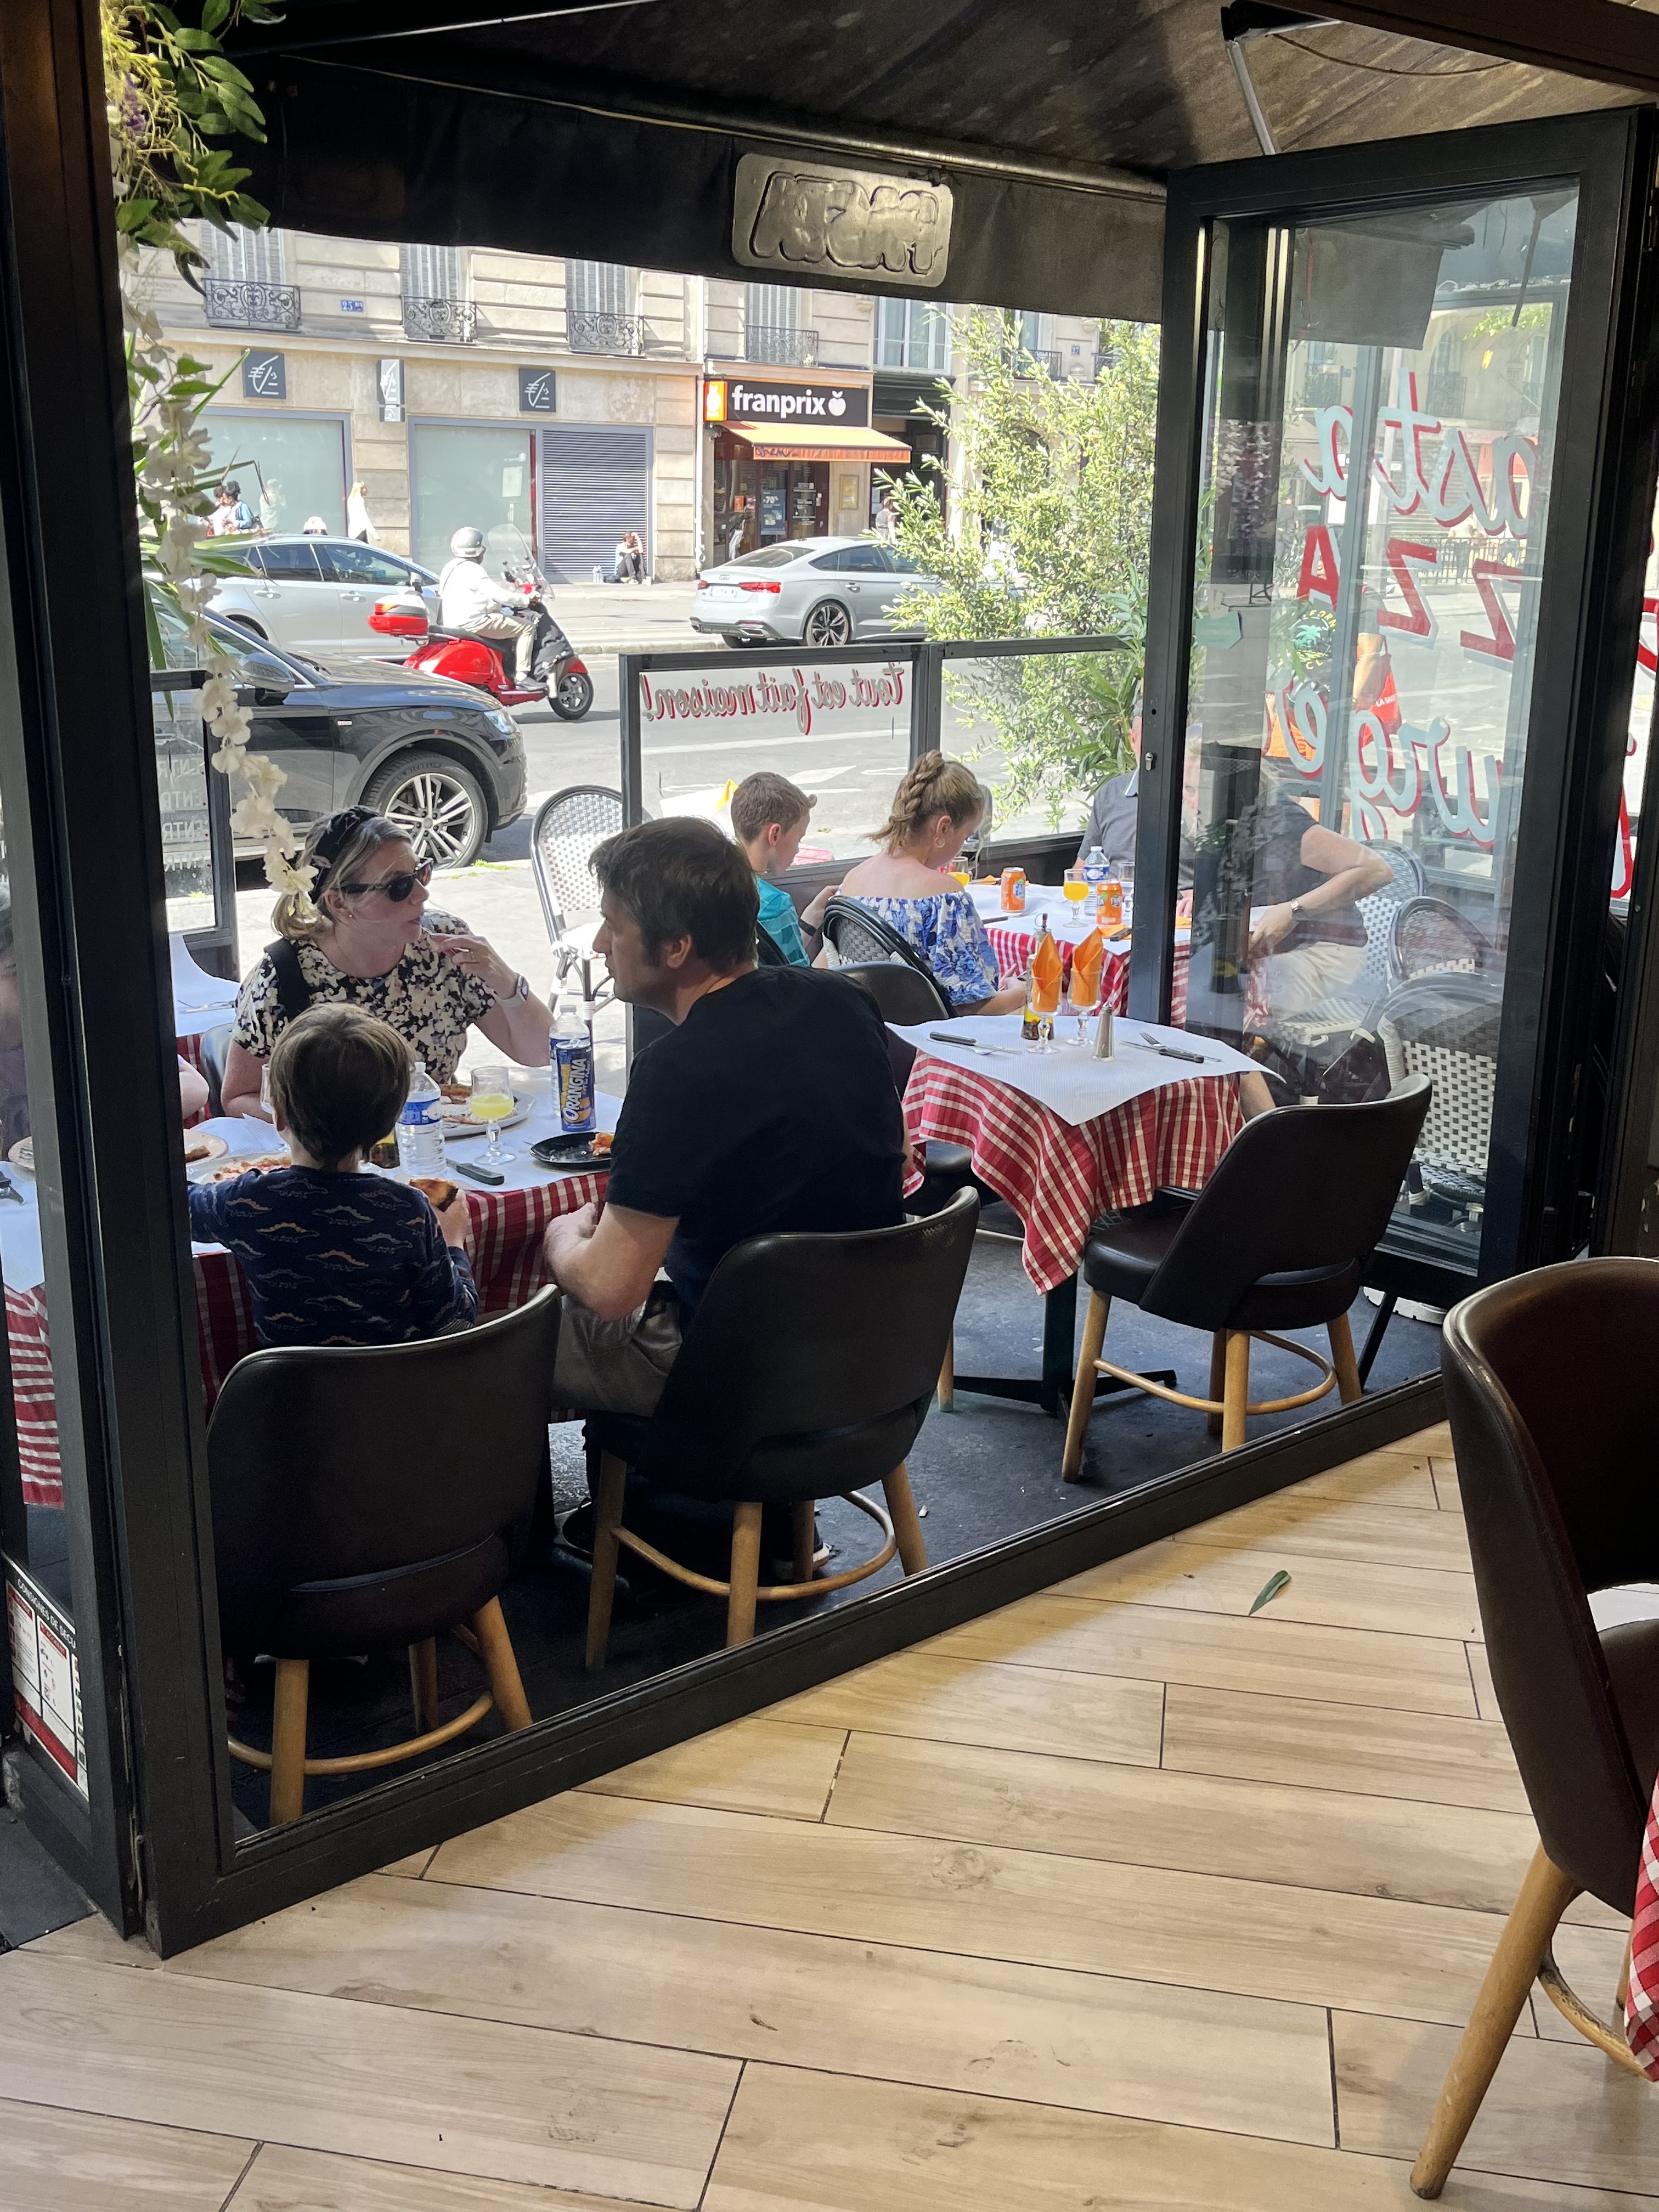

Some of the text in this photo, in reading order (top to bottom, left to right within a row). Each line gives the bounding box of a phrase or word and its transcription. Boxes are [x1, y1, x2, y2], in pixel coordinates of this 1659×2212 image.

[731, 385, 827, 419] franprix
[562, 1058, 587, 1121] ORANGINA
[50, 1615, 59, 1631] DE
